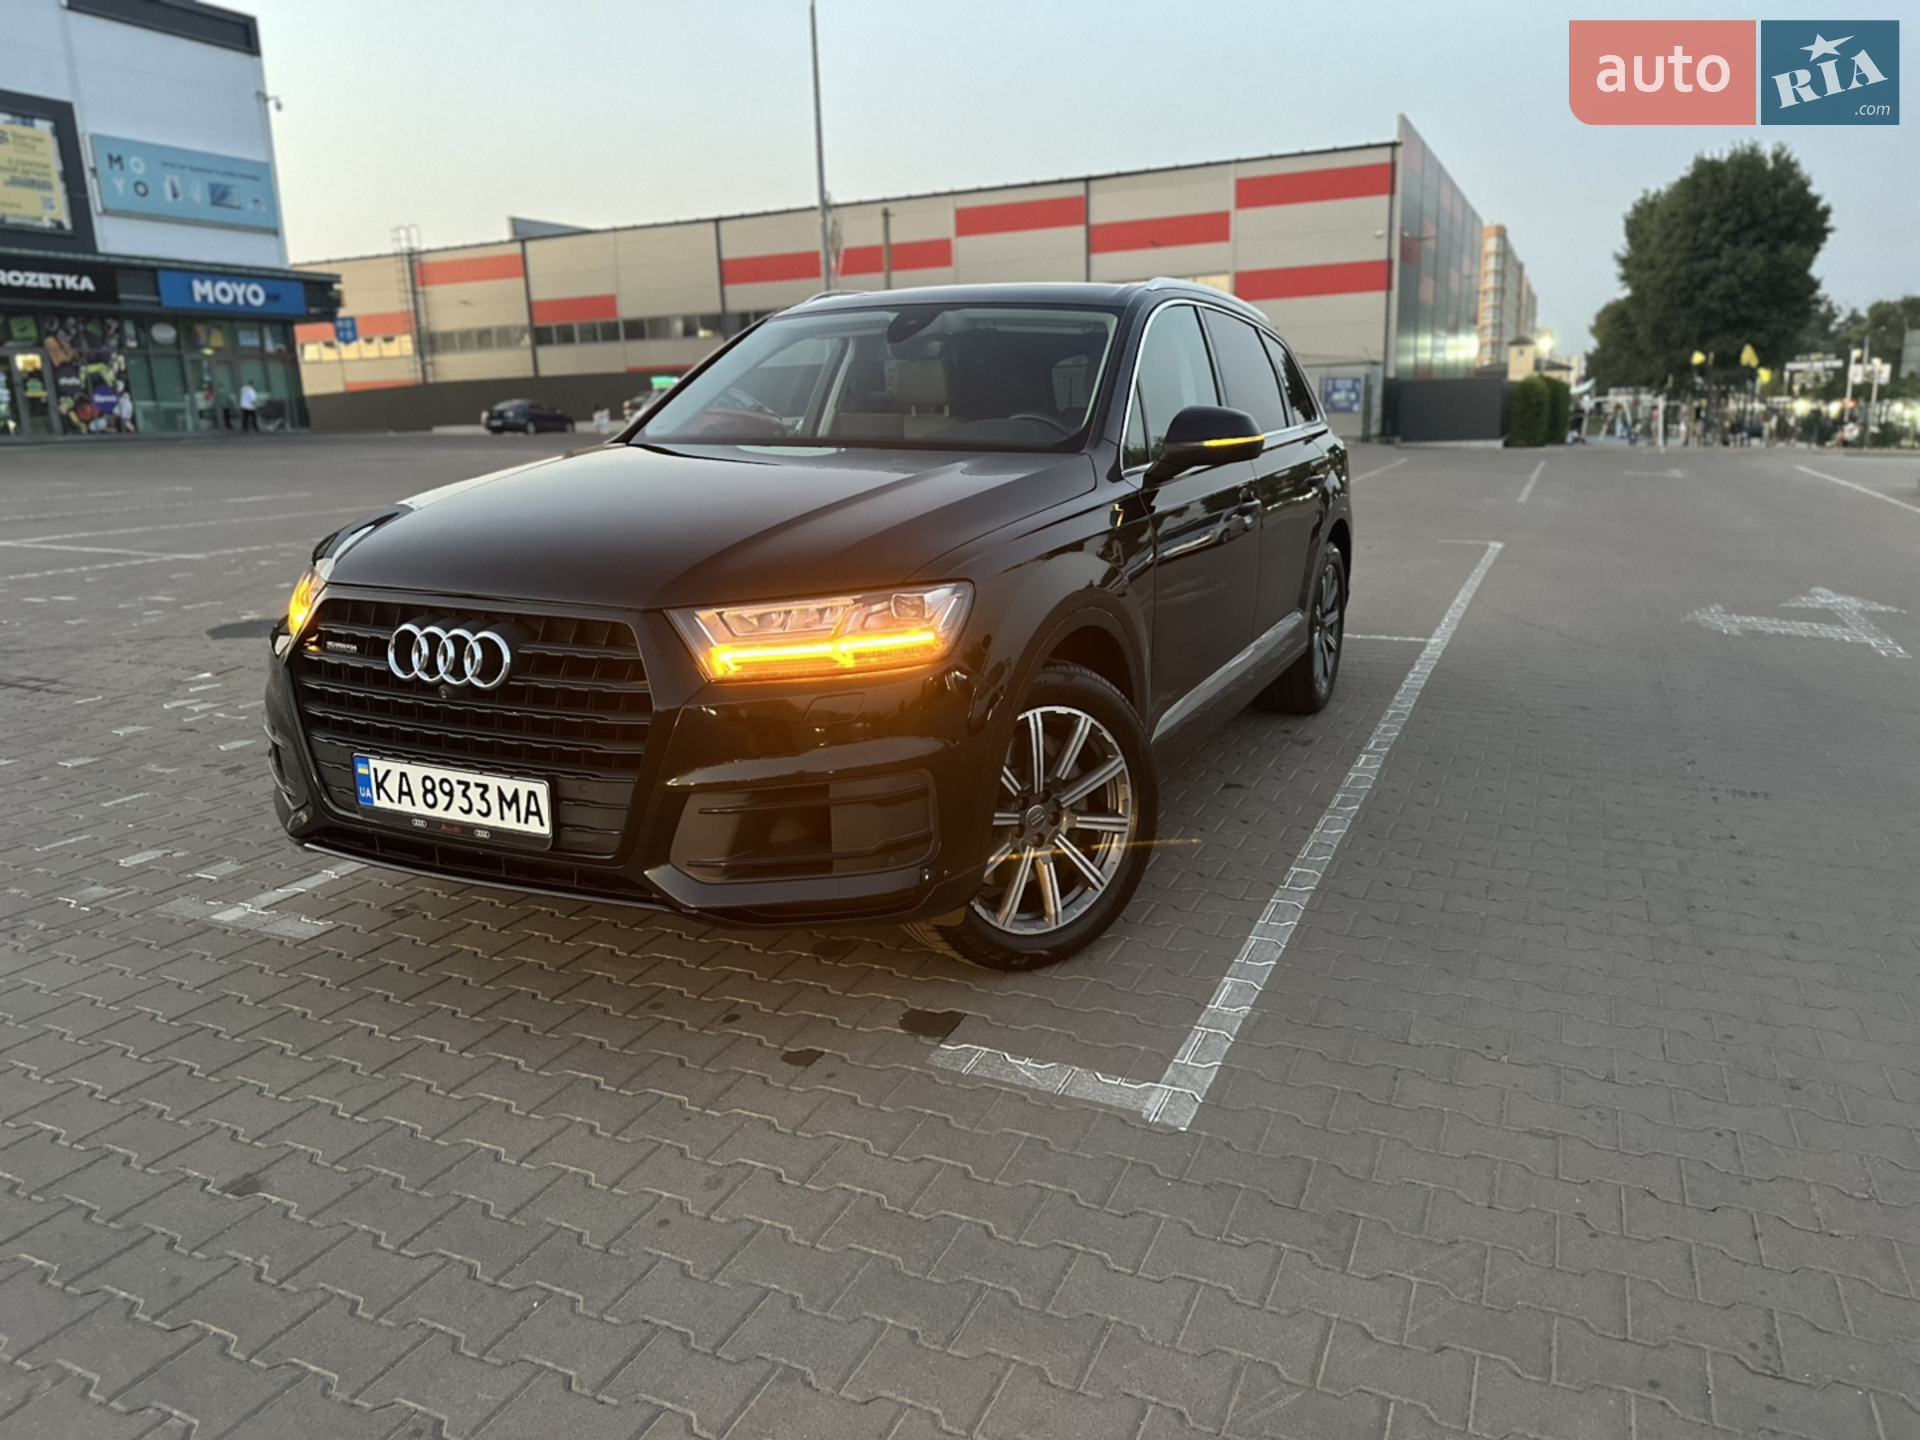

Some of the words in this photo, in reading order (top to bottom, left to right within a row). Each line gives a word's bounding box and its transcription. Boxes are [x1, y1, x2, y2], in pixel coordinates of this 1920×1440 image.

[191, 278, 266, 307] MOYO
[359, 787, 372, 798] UA
[441, 823, 461, 834] Audi
